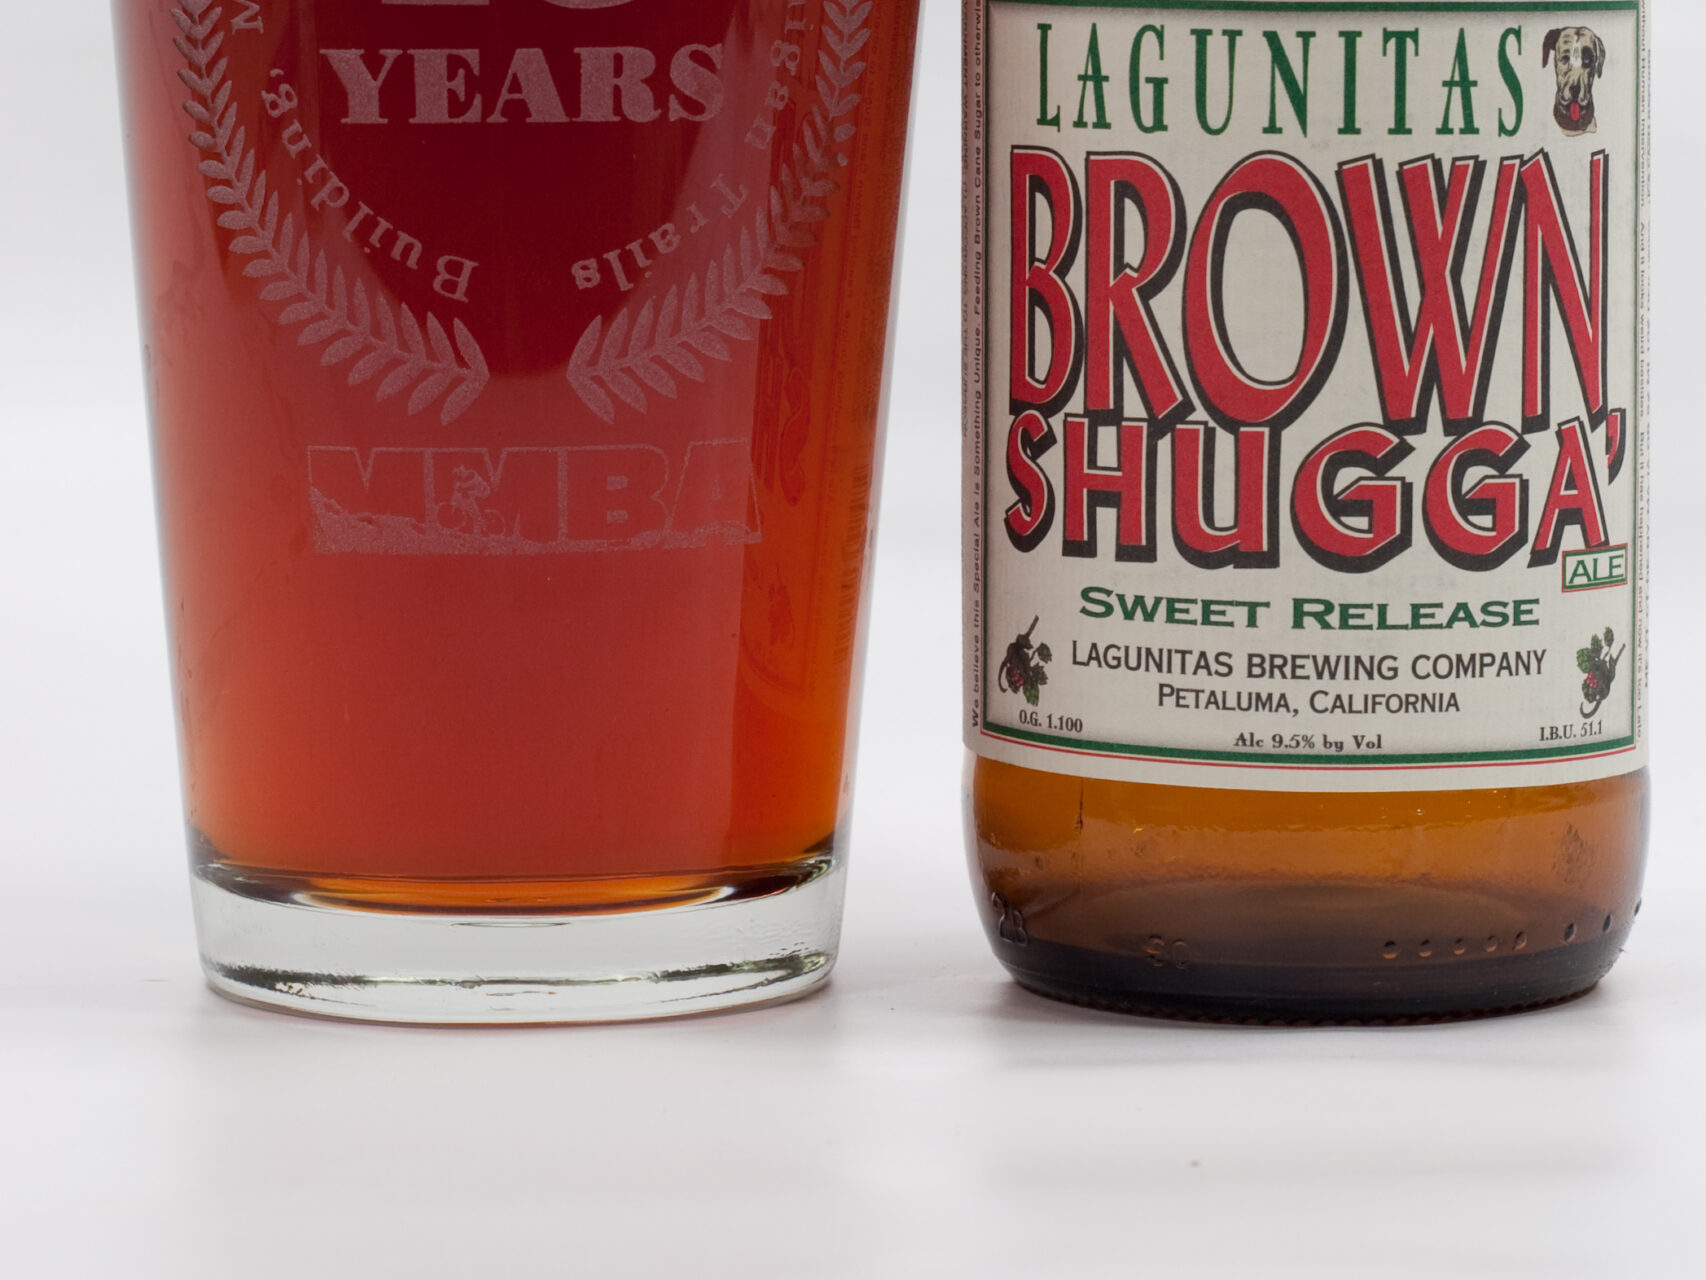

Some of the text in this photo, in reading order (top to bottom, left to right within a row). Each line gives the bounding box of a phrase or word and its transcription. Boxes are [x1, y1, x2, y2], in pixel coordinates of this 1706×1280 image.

[320, 43, 724, 125] YEARS
[1036, 23, 1525, 138] LAGUNITAS
[974, 93, 982, 140] Sugar
[260, 67, 748, 304] Building, Trails
[974, 252, 982, 316] Feeding
[1009, 145, 1608, 432] BROWN
[974, 391, 982, 475] Something
[306, 439, 763, 555] MMBA
[1004, 409, 1627, 573] SHUGGA'
[973, 535, 981, 593] Special
[1567, 555, 1627, 585] ALE
[1079, 586, 1541, 631] SWEET RELEASE
[972, 634, 980, 693] believe
[1071, 640, 1548, 681] LAGUNITAS BREWING COMPANY
[972, 700, 980, 728] We
[1019, 709, 1084, 733] O.G. 1.100
[1158, 683, 1461, 717] PETALUMA, CALIFORNIA
[1233, 732, 1382, 752] Alc 9.5% by Vol
[1540, 720, 1603, 742] I.B.U. 51.1
